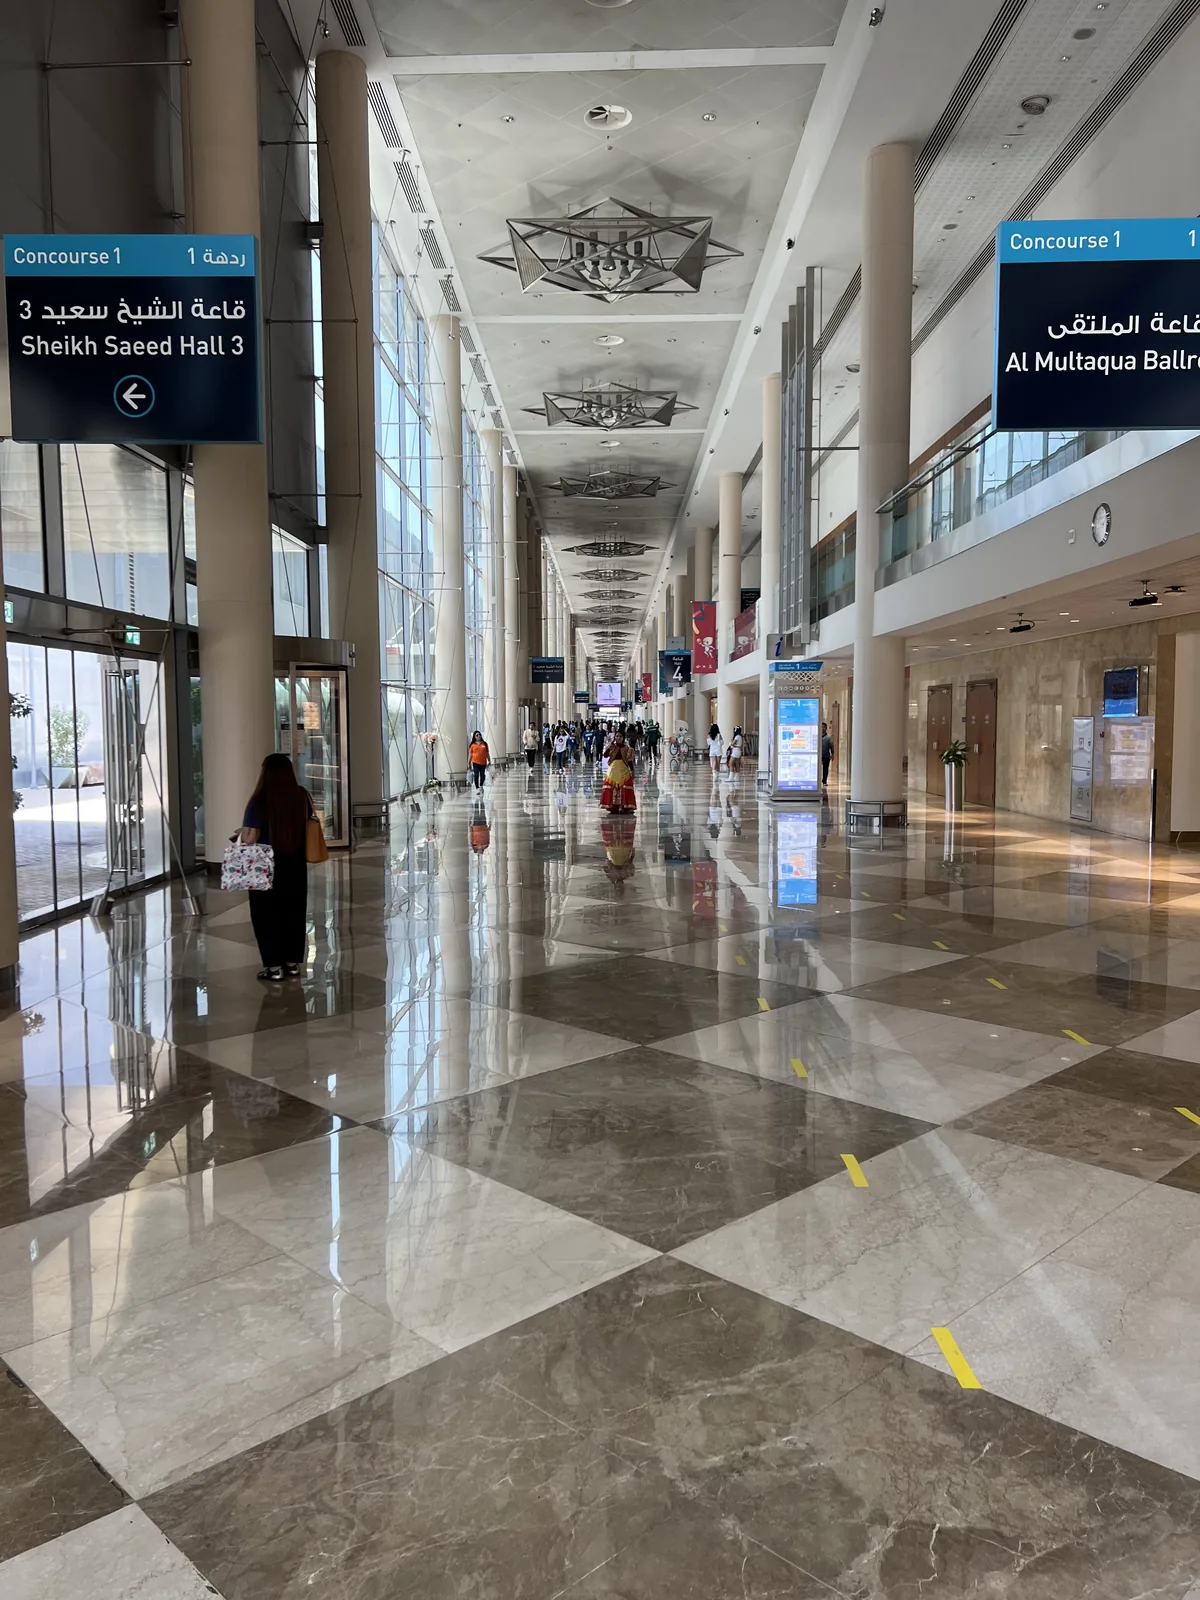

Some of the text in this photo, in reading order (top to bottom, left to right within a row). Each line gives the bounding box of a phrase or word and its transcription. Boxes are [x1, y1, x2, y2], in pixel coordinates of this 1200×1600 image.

[1010, 230, 1121, 250] Concourse 1
[1188, 229, 1196, 247] 1
[13, 247, 121, 264] Concourse 1
[187, 247, 246, 268] ردهة 1
[19, 296, 246, 325] قاعة الشيخ سعيد 3
[1047, 313, 1140, 340] الملتقى
[21, 335, 244, 356] Sheikh Saeed Hall 3
[1005, 349, 1200, 376] Al Multaqua Ballr
[672, 665, 683, 681] 4
